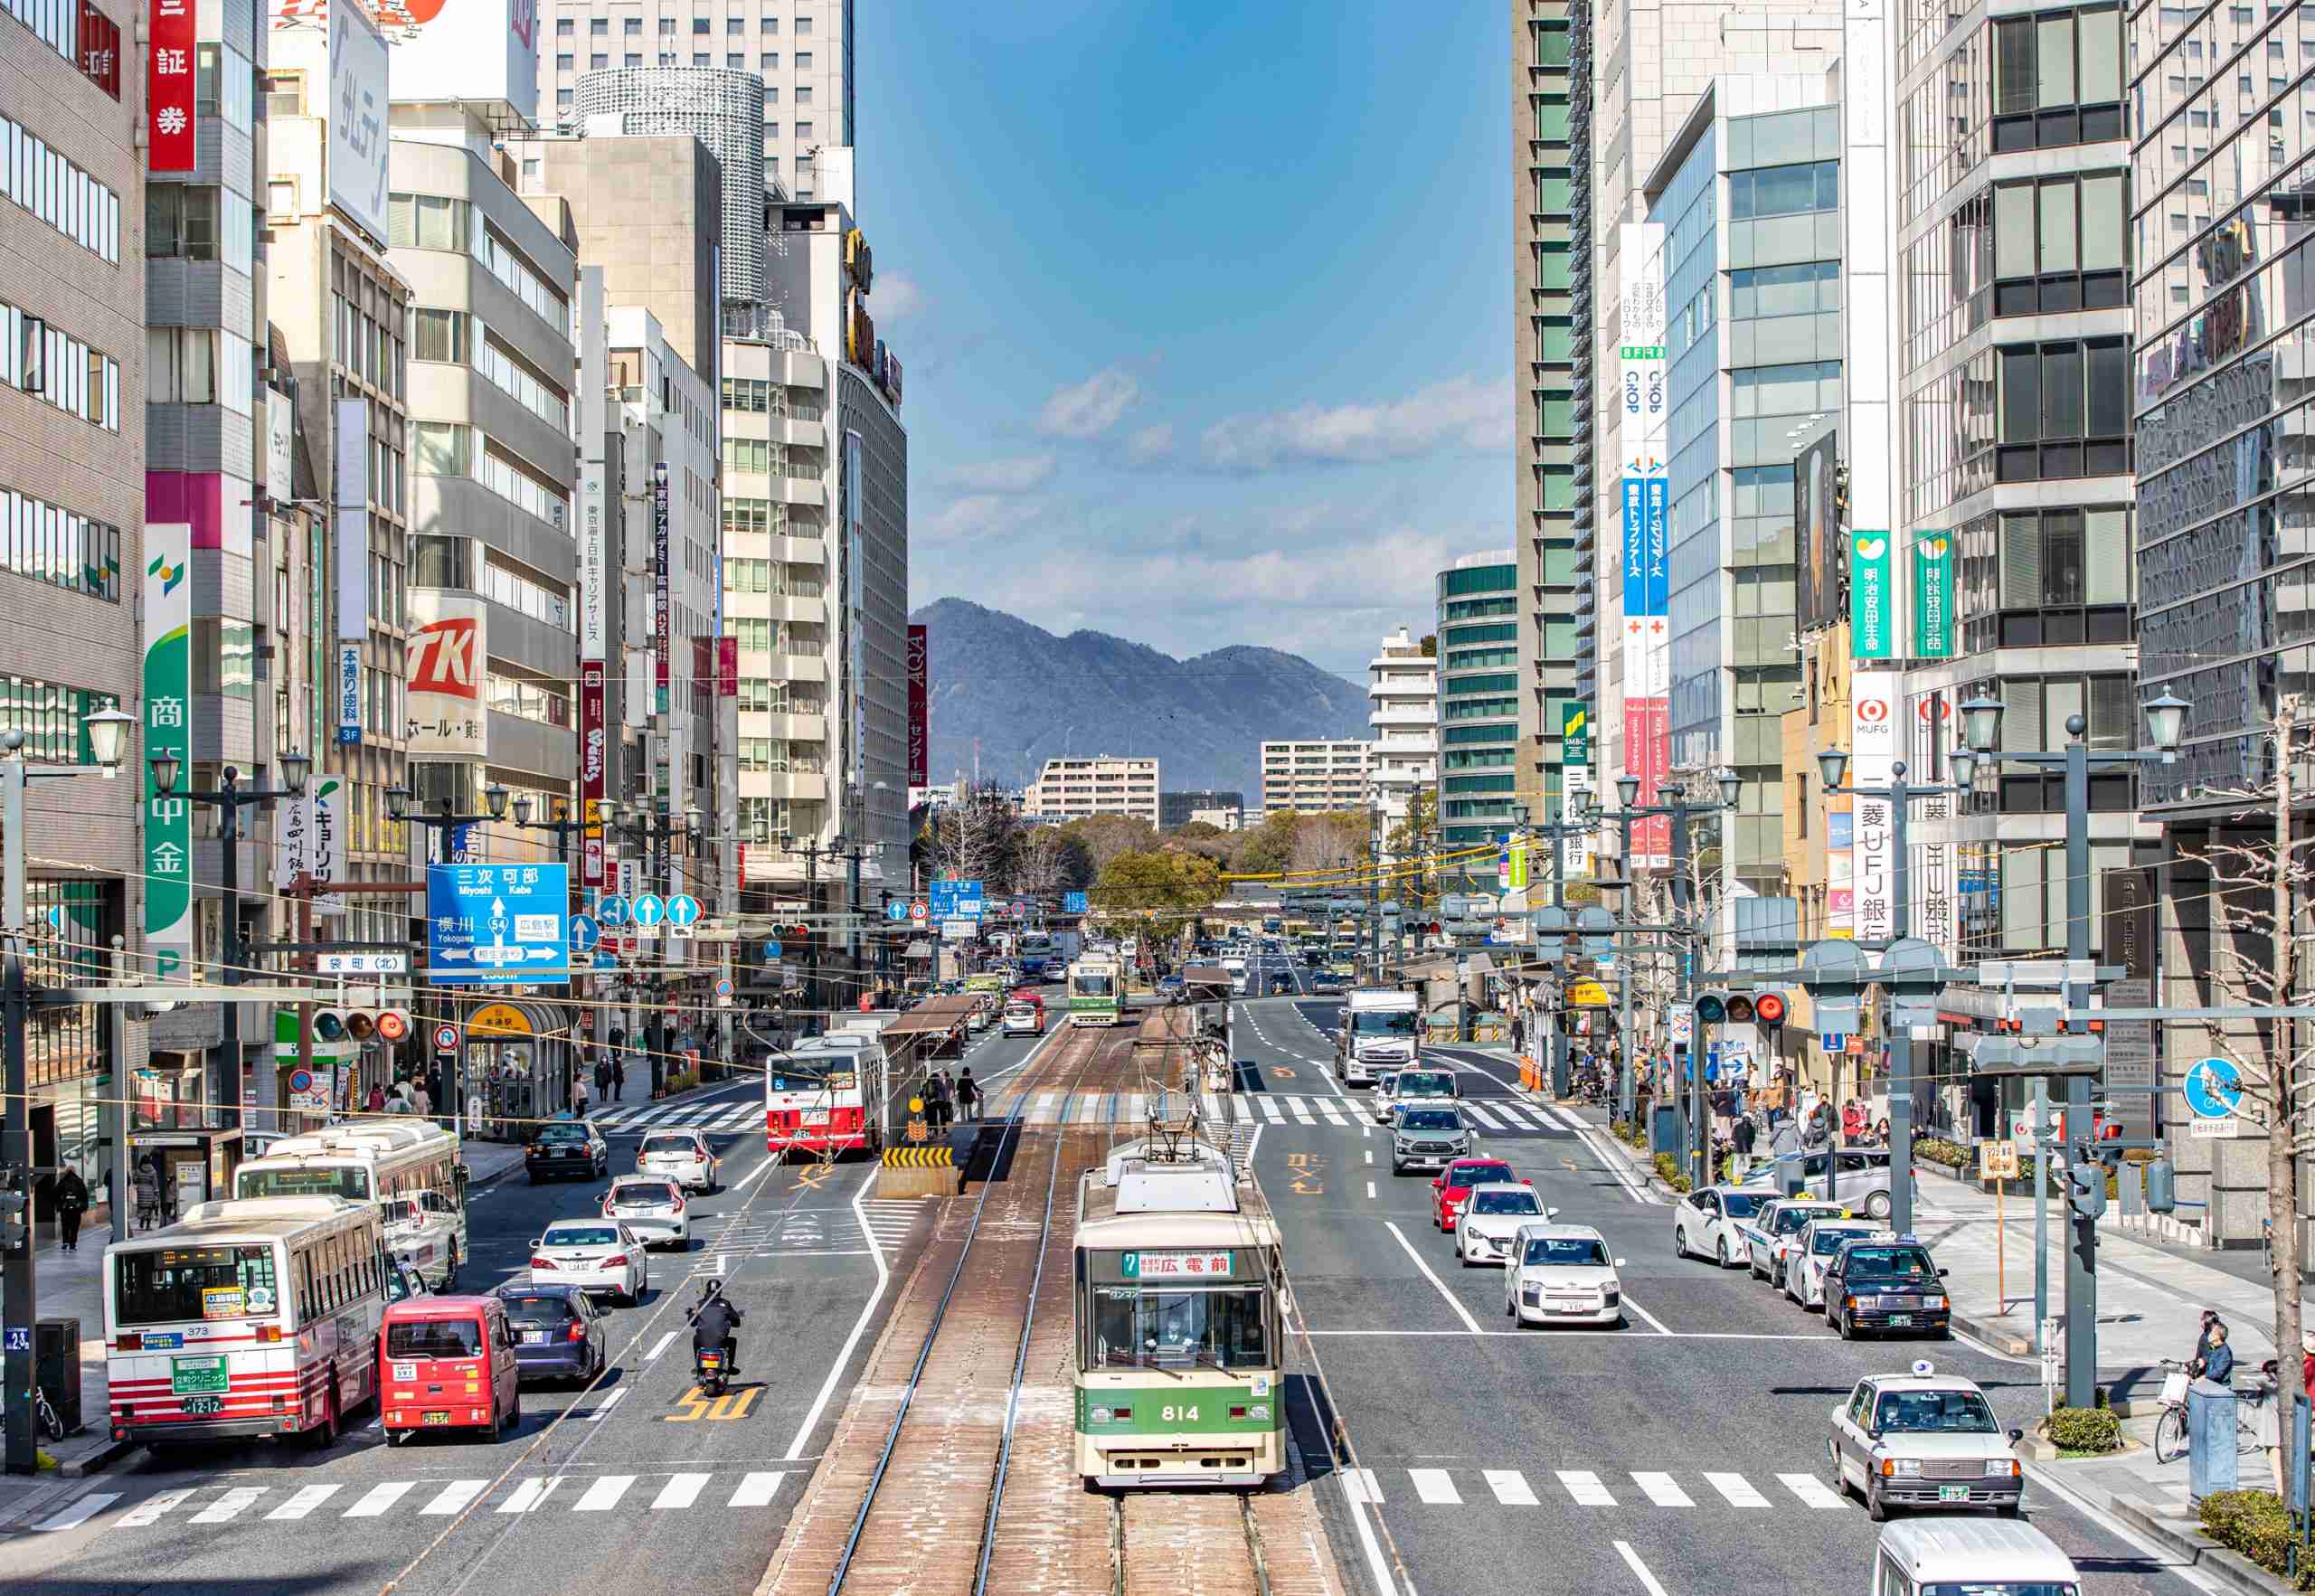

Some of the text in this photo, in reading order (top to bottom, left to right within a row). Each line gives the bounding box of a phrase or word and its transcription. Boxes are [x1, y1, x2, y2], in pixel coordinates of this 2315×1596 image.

[1864, 568, 1878, 651] 明治安田生命
[343, 648, 356, 722] 本通り歯科
[343, 730, 357, 740] 3F
[1856, 725, 1888, 733] MUFG
[584, 727, 603, 782] Wants
[458, 867, 539, 884] 三次 可部
[458, 886, 532, 897] Miyoshi Kabe
[438, 916, 474, 932] 横川
[492, 921, 506, 930] 54
[438, 935, 475, 943] Yokogawa
[1125, 1253, 1136, 1272] 7
[1161, 1257, 1228, 1273] 広電前
[187, 1327, 209, 1336] 373
[1161, 1406, 1199, 1421] 814
